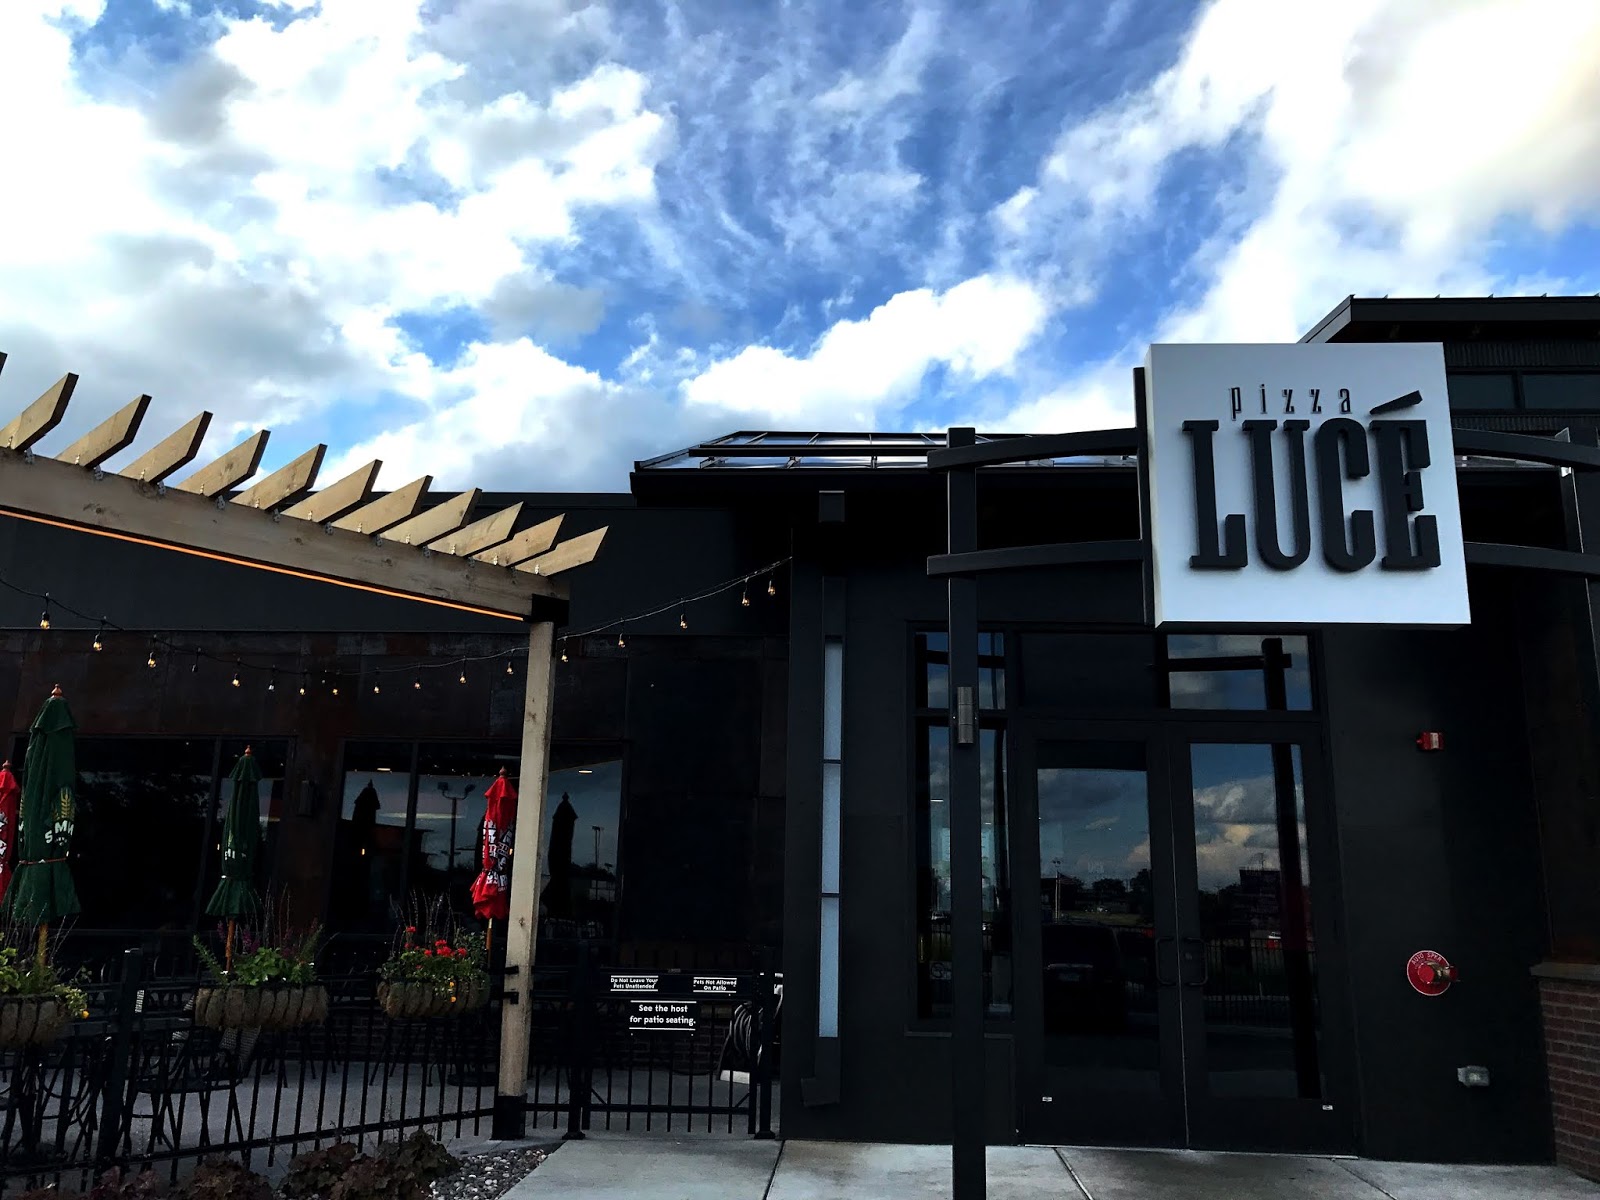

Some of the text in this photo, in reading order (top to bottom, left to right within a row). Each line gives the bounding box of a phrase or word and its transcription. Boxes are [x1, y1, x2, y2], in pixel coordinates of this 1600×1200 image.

[1229, 383, 1352, 420] pizza
[1182, 390, 1442, 573] LUCÉ
[1411, 953, 1424, 965] AUTO
[638, 1004, 688, 1013] See the host
[629, 1015, 697, 1027] for patio seating.
